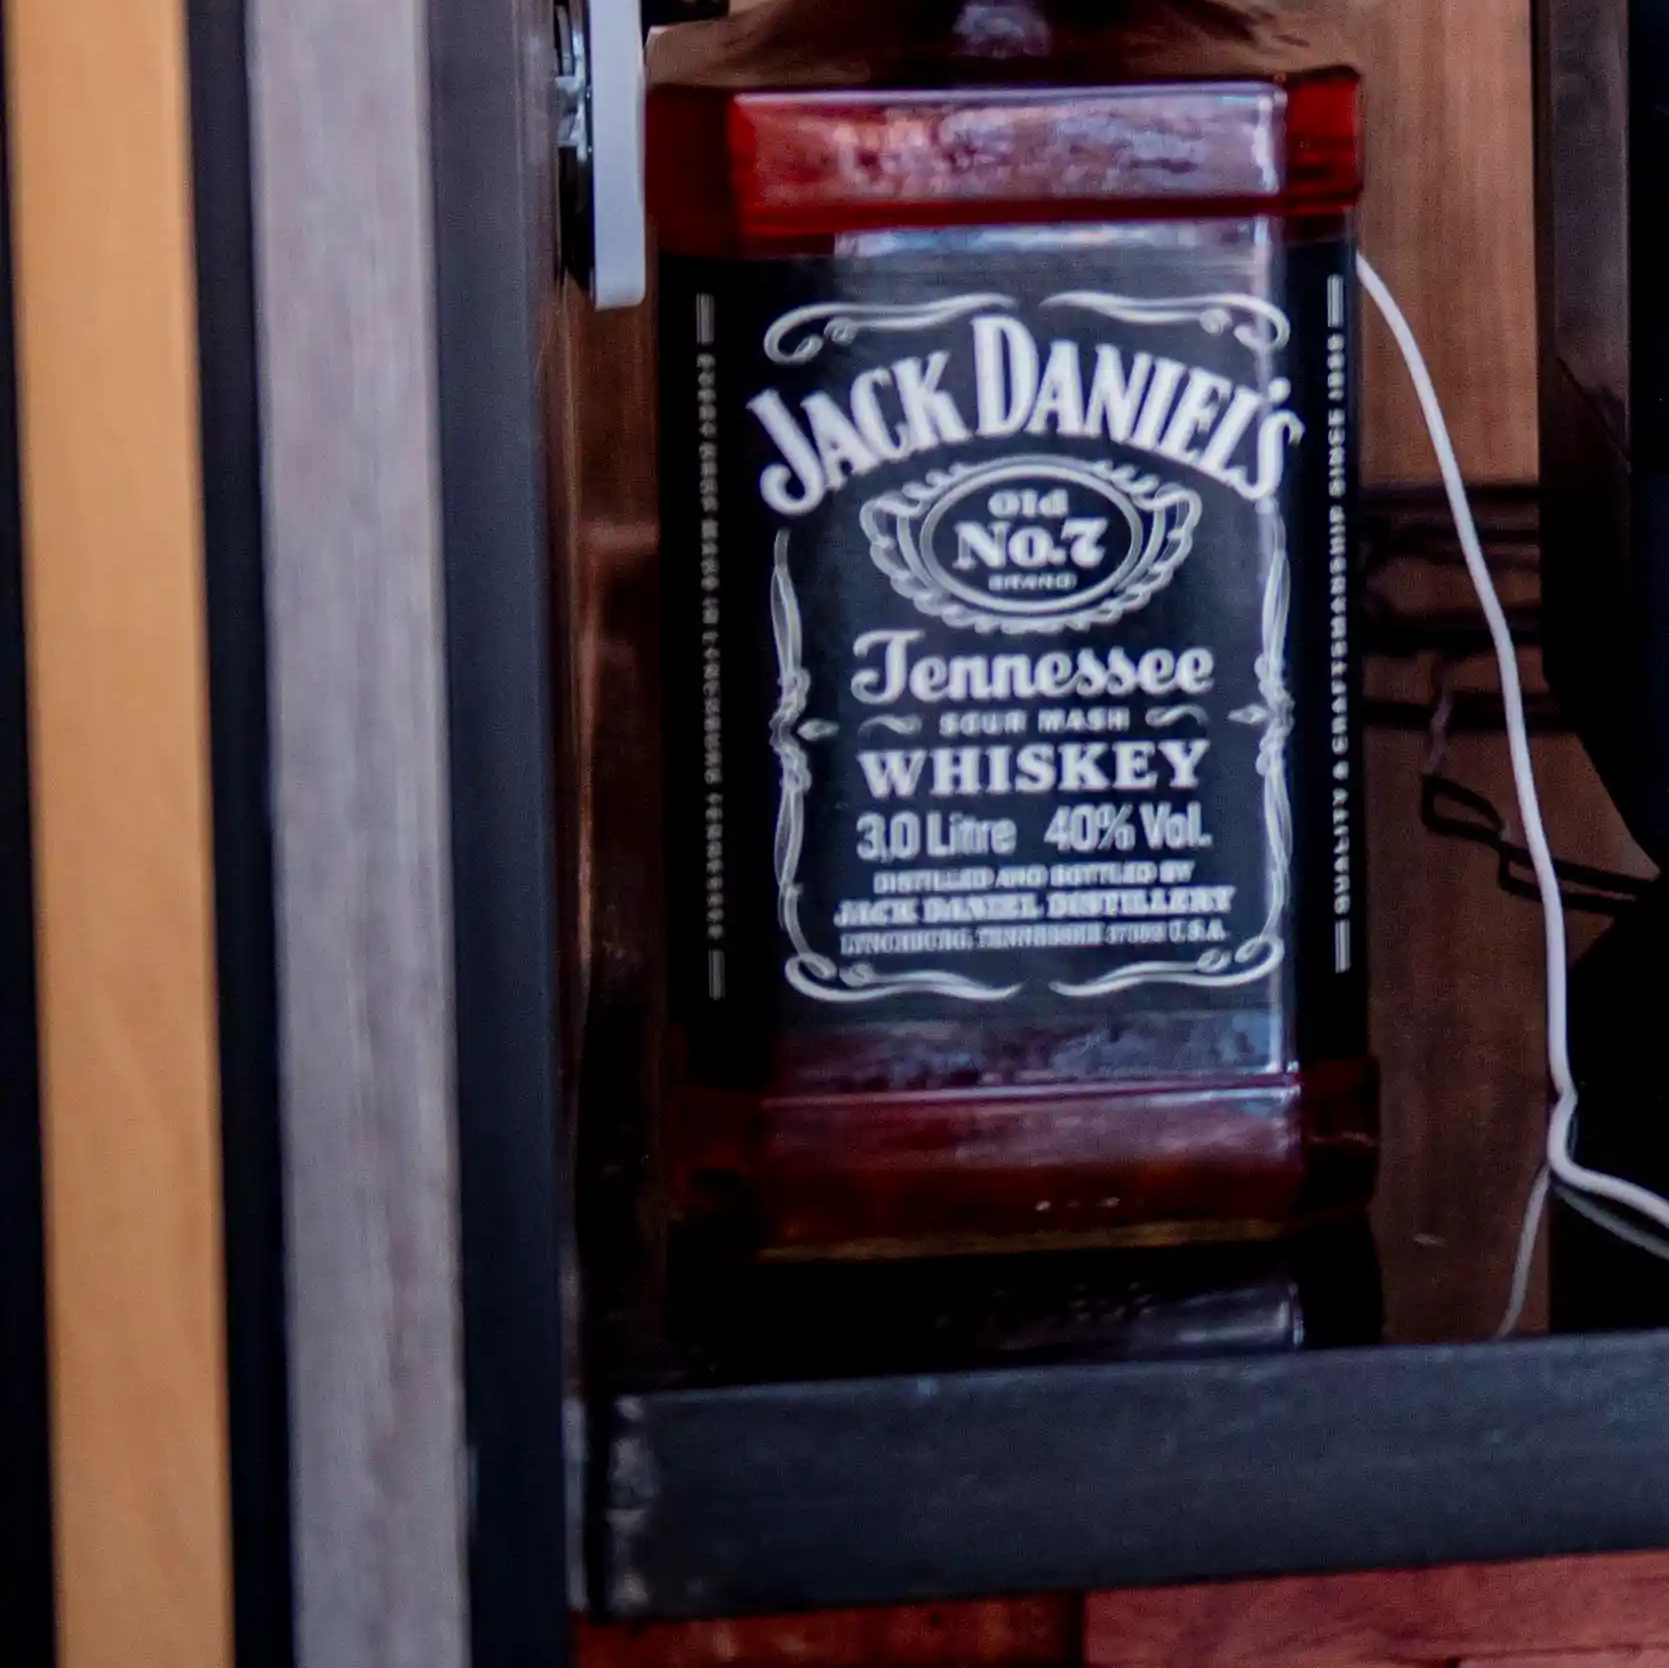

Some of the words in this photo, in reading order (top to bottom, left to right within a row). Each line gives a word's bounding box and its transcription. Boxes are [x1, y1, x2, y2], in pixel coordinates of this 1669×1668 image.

[746, 348, 974, 516] JACK
[970, 315, 1305, 501] DANIEL'S
[987, 488, 1070, 519] Old
[850, 630, 1215, 705] Tennessee
[938, 712, 1028, 738] SOUR
[1037, 707, 1131, 733] MASH
[857, 738, 1211, 799] WHISKEY
[926, 809, 1018, 858] Litre
[1043, 802, 1137, 853] 40%
[1139, 801, 1214, 850] Vol.
[833, 900, 917, 927] JACK
